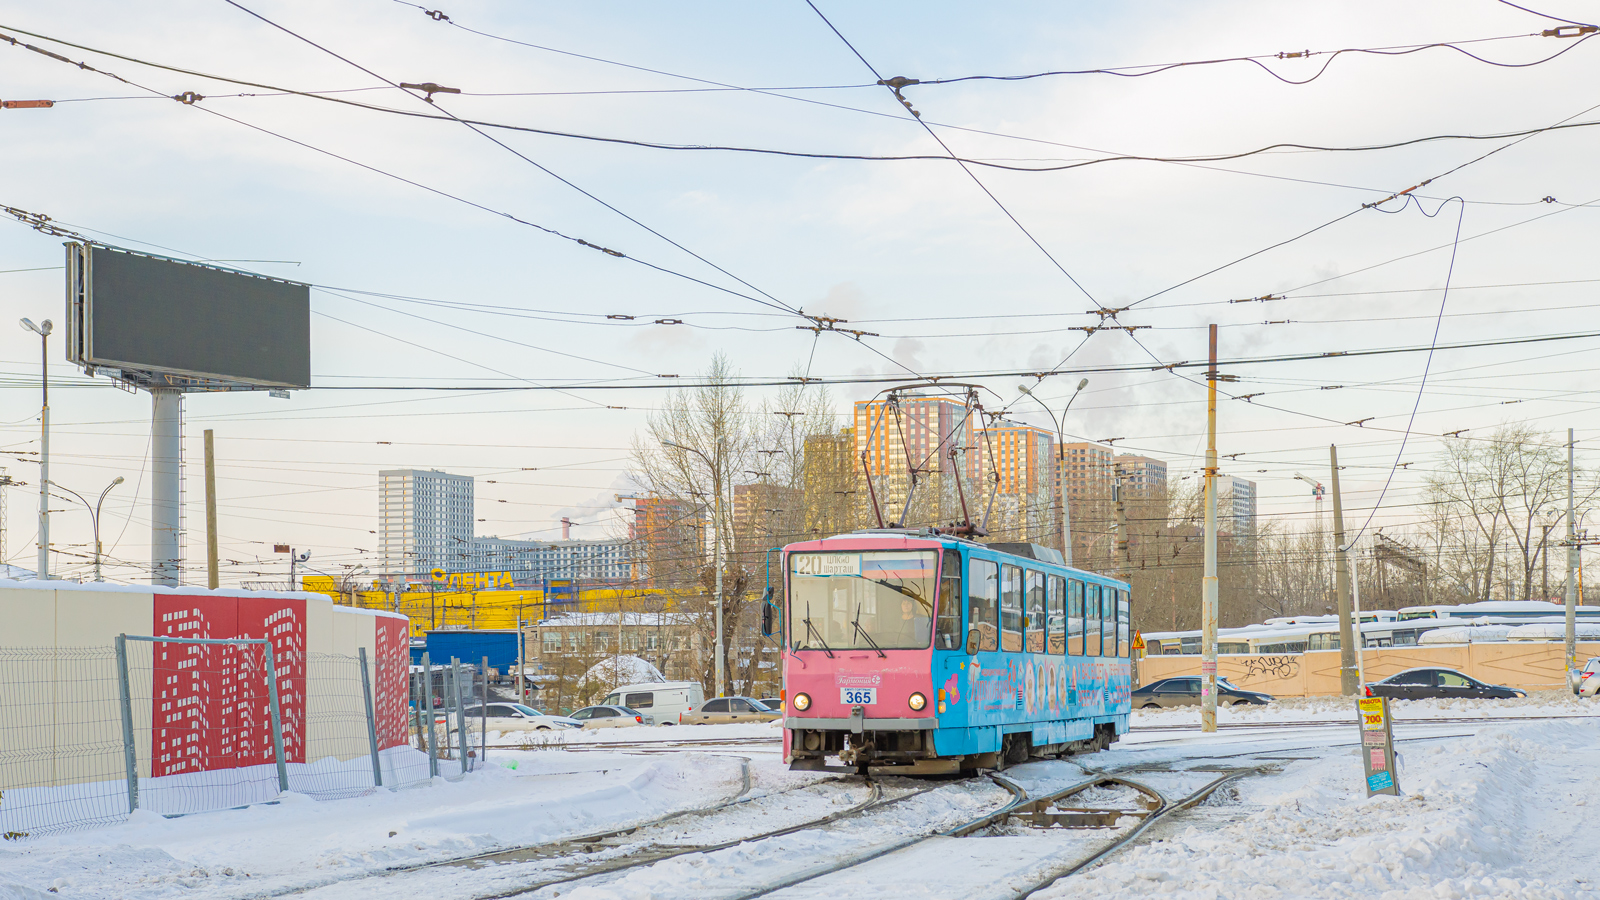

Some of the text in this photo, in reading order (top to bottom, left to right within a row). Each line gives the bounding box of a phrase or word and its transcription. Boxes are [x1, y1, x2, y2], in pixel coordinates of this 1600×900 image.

[799, 555, 822, 575] 20
[447, 571, 515, 588] ЛЕНТА
[846, 692, 871, 704] 365
